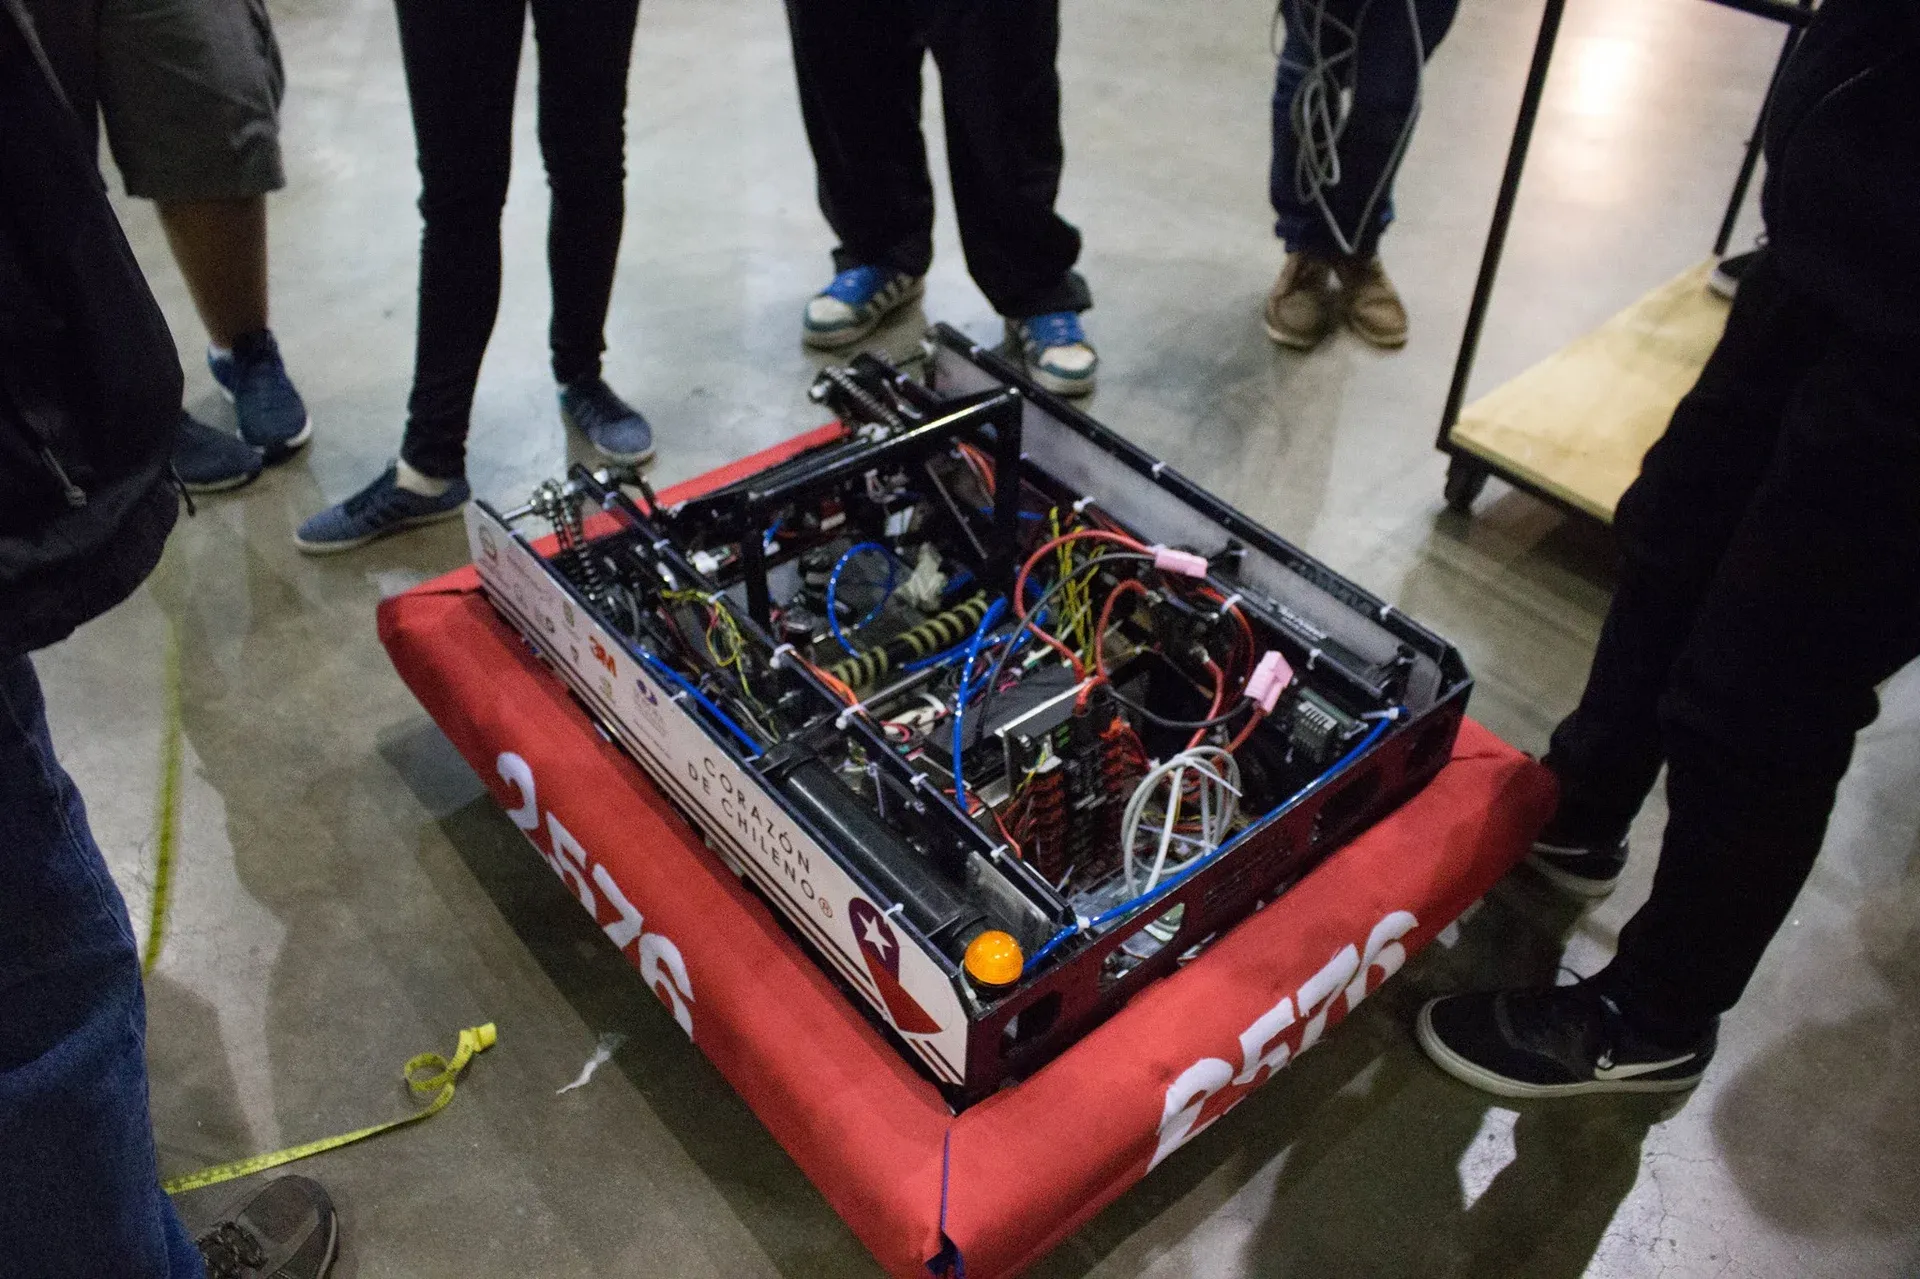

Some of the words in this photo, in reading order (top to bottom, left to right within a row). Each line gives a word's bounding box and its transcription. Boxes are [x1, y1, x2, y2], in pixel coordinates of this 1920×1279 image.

[589, 635, 618, 679] 3M
[688, 762, 711, 795] DE
[703, 756, 811, 874] CORAZÓN
[497, 752, 696, 1043] 2576
[1146, 910, 1420, 1174] 2576
